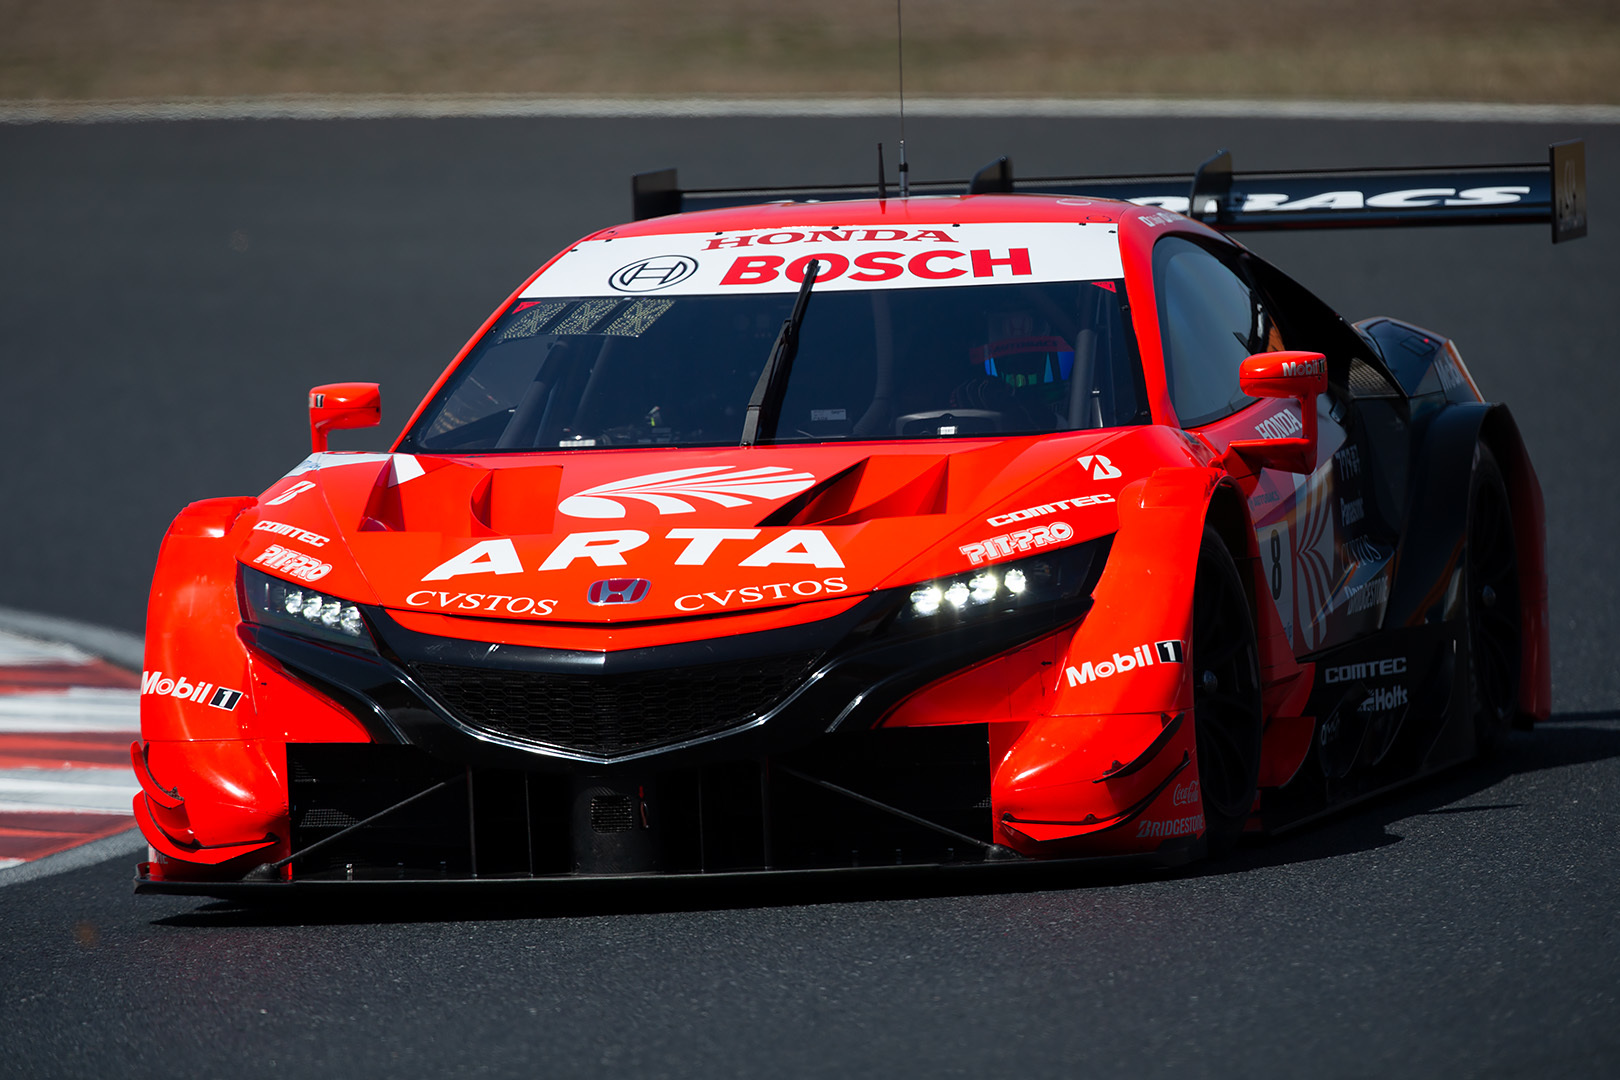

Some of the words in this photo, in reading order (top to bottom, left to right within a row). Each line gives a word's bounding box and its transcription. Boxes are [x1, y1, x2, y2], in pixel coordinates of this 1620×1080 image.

[701, 229, 959, 251] HONDA
[719, 247, 1032, 285] BOSCH
[1281, 359, 1318, 376] Mobil
[1255, 408, 1302, 439] HONDA
[987, 494, 1115, 527] COMTEC
[253, 520, 330, 547] COMTEC
[421, 528, 845, 581] ARTA
[1270, 529, 1283, 600] 8
[406, 590, 558, 616] CVSTOS
[674, 577, 848, 611] CVSTOS
[1066, 644, 1153, 687] Mobil
[1325, 656, 1407, 684] COMTEC
[141, 670, 213, 704] Mobil
[1375, 684, 1408, 712] Holts
[1136, 813, 1205, 838] BRIDGESTONE
